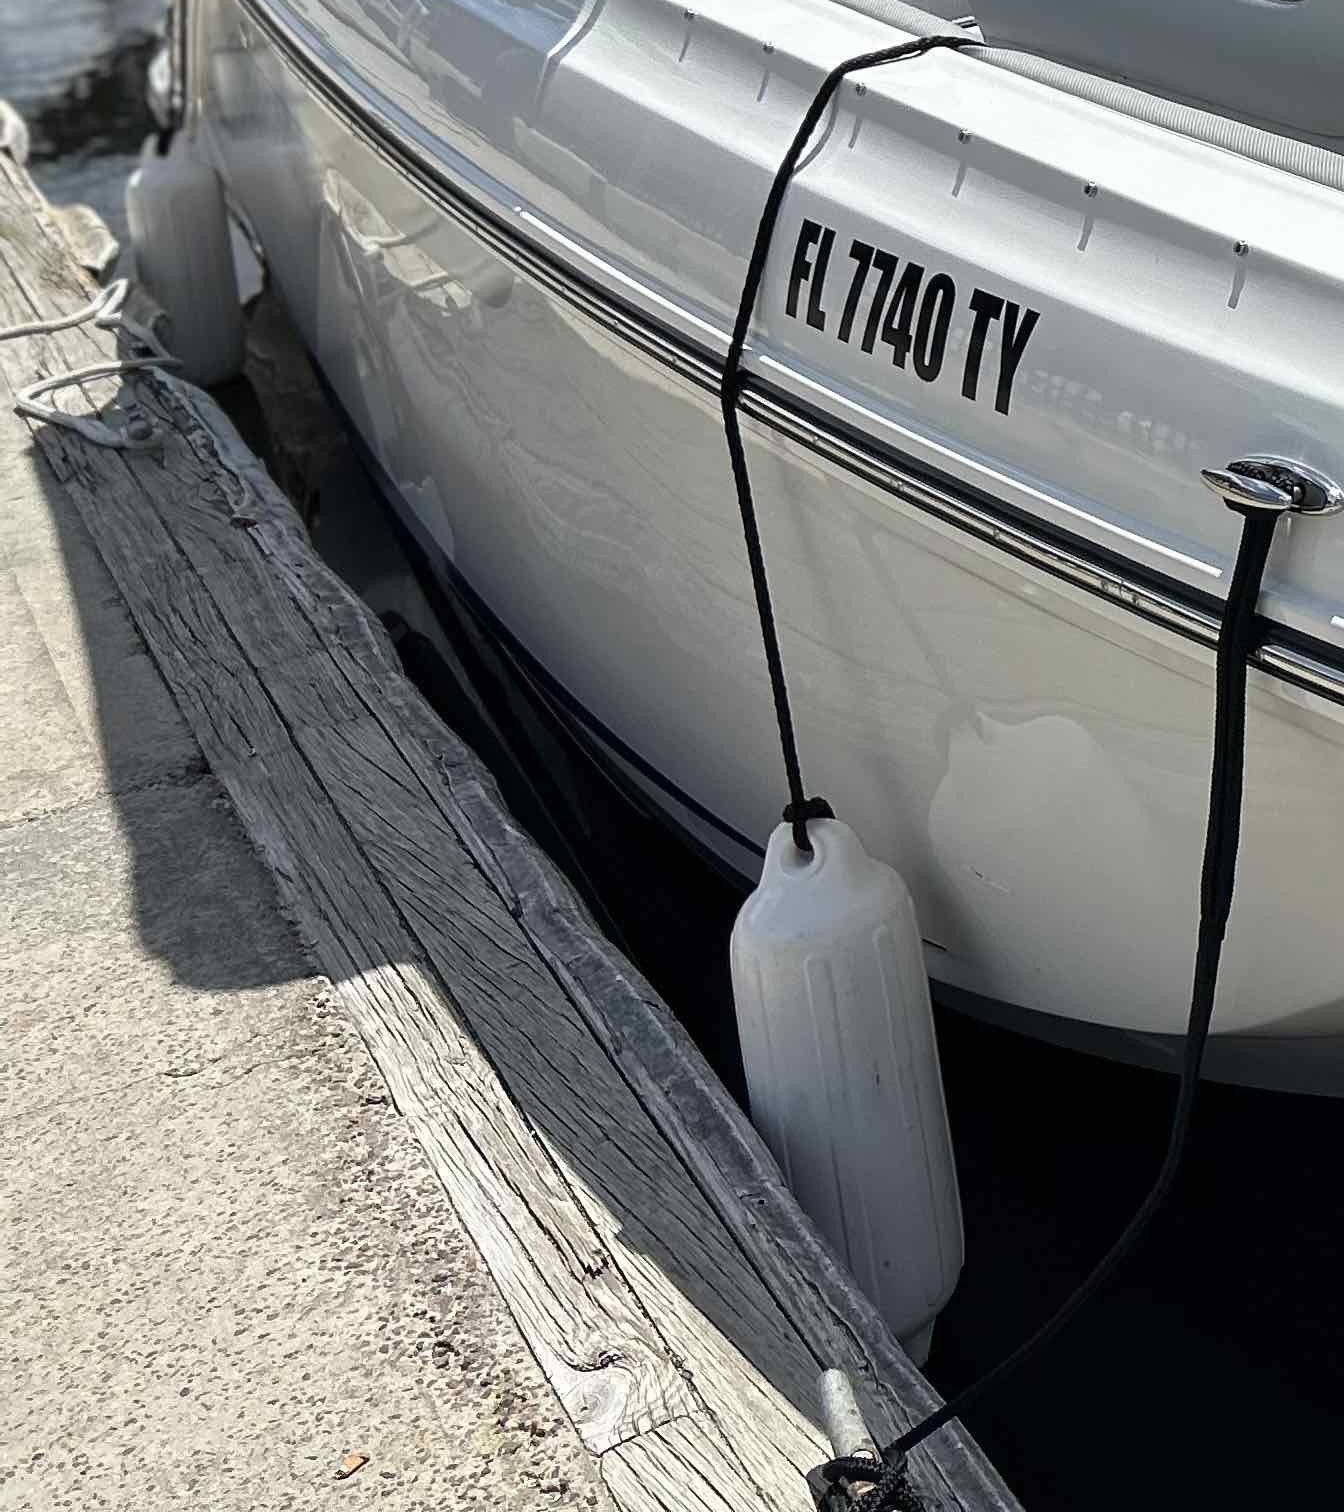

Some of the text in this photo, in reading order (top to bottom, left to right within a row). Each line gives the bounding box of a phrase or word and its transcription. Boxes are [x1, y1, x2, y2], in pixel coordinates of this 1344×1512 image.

[785, 218, 837, 332] FL
[838, 239, 956, 383] 7740
[961, 288, 1040, 416] TY
